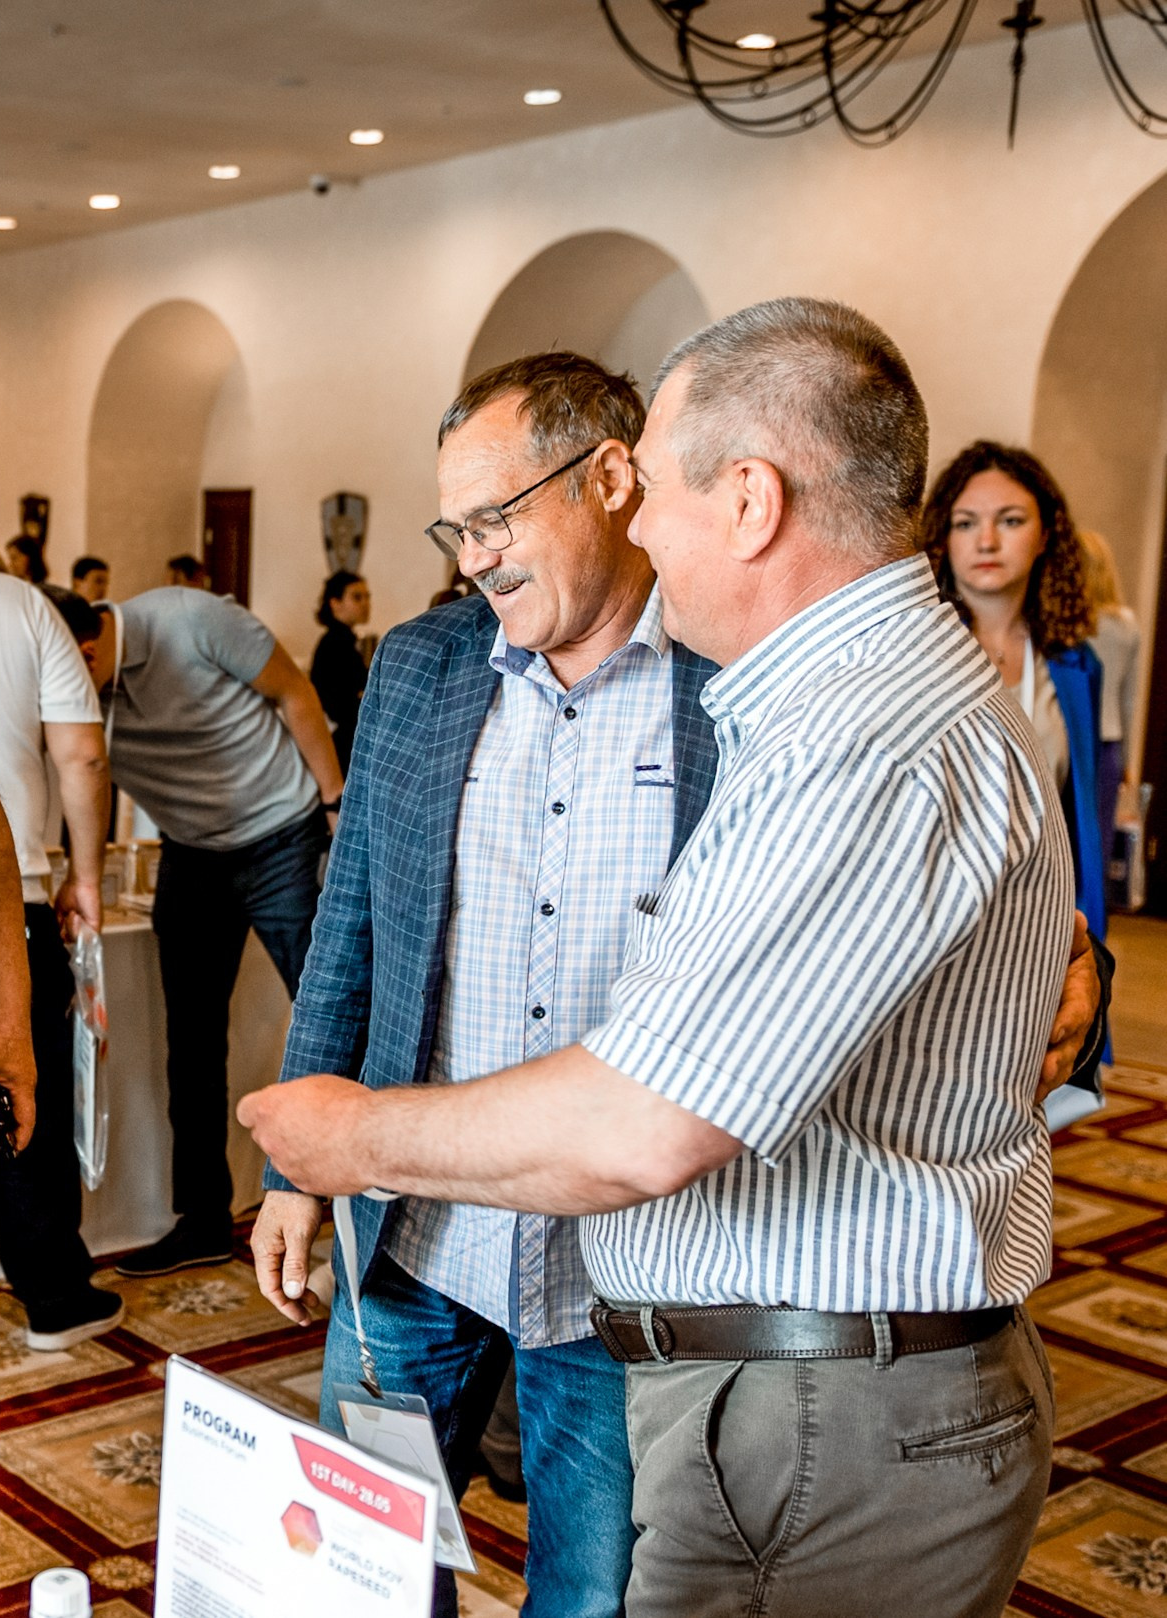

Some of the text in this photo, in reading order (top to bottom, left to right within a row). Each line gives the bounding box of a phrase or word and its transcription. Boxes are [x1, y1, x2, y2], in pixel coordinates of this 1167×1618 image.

[181, 1421, 219, 1448] Business
[184, 1400, 256, 1450] PROGRAM
[310, 1461, 331, 1482] 1ST
[328, 1557, 391, 1600] RAPESEED
[330, 1542, 404, 1585] WORLD SOY
